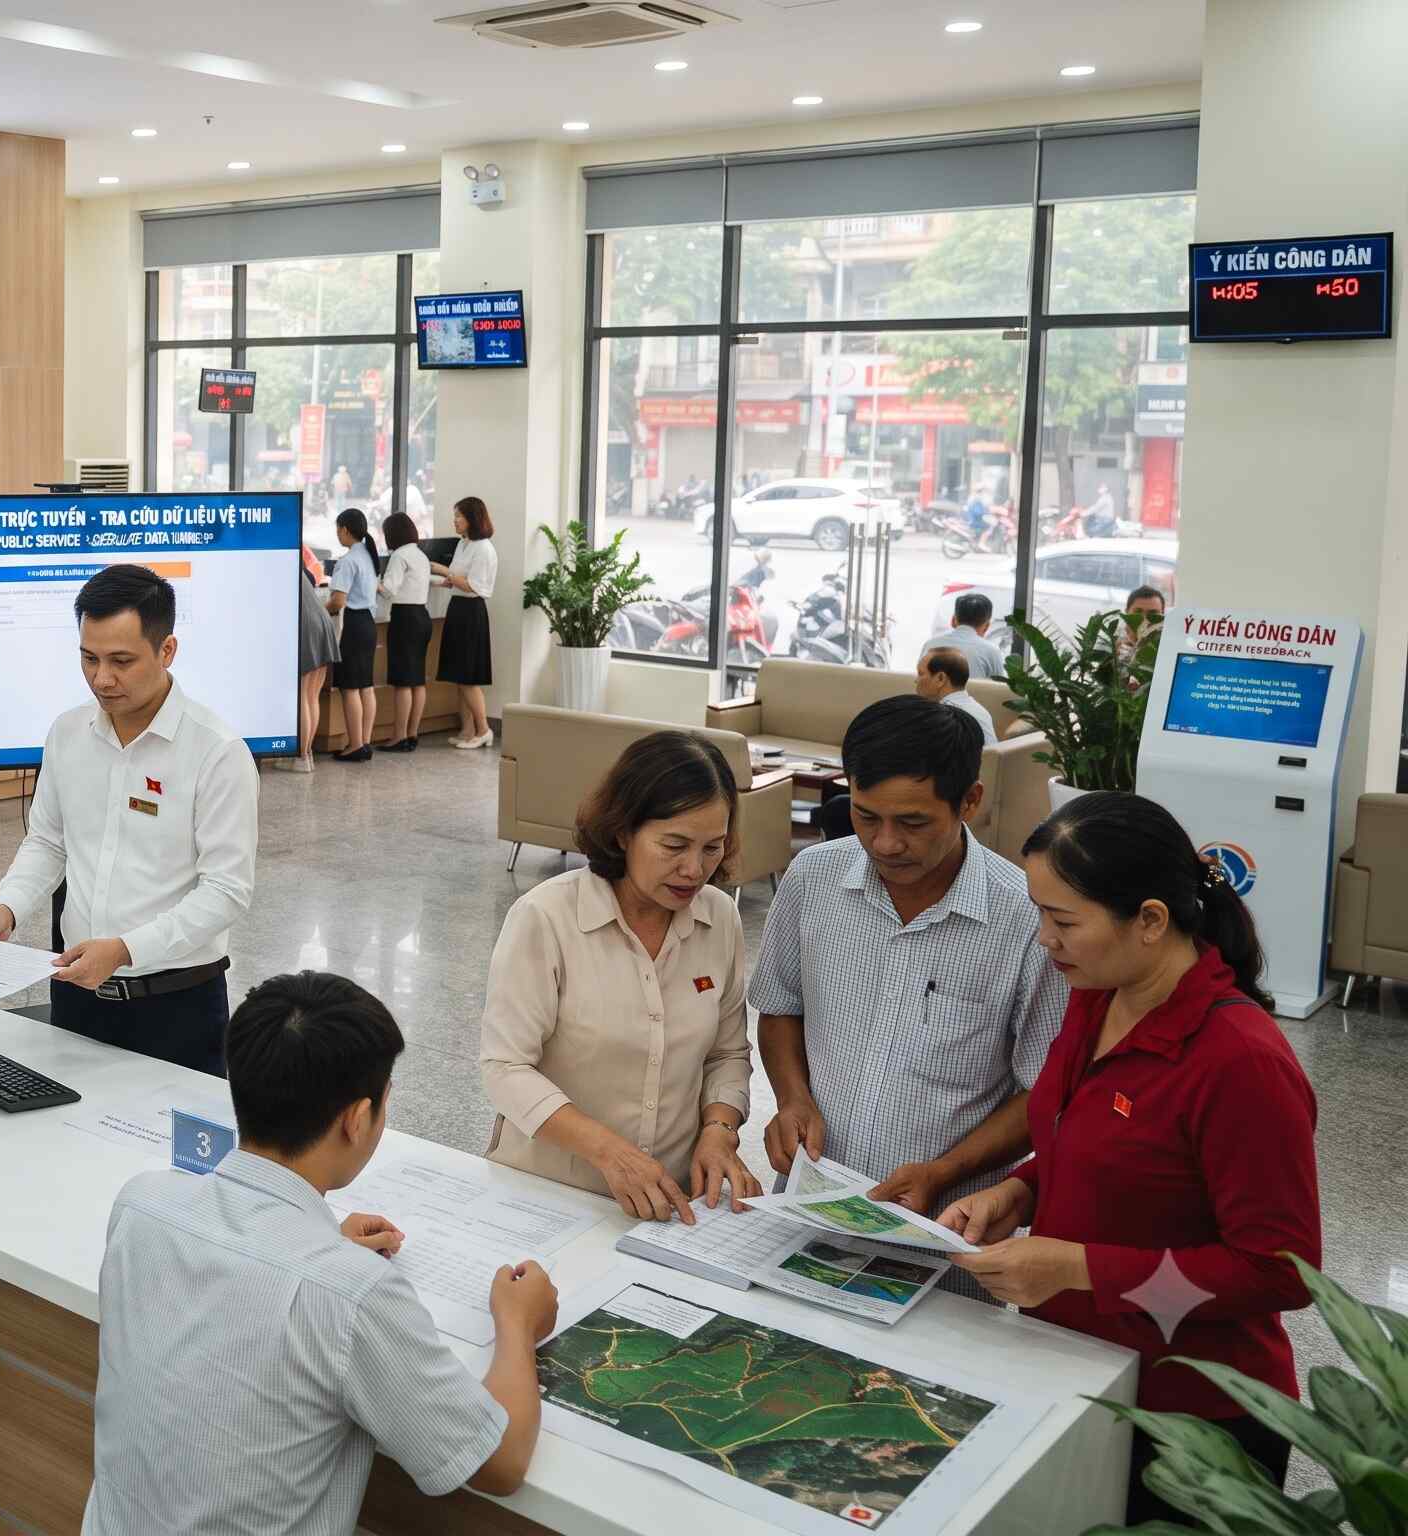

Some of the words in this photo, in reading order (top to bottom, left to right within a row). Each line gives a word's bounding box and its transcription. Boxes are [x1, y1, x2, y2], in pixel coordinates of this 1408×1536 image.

[1209, 250, 1222, 272] Ý
[1227, 246, 1269, 271] KIẾN
[1274, 247, 1326, 269] CÔNG
[1331, 244, 1372, 266] DÂN
[0, 509, 37, 532] TRỰC
[41, 505, 86, 527] TUYẾN
[99, 510, 127, 526] TRA
[130, 505, 159, 526] CỨU
[162, 505, 185, 526] DỮ
[185, 504, 216, 527] LIỆU
[218, 504, 236, 529] VỆ
[239, 507, 272, 524] TINH
[35, 533, 81, 548] SERVICE
[144, 531, 170, 545] DATA
[1184, 614, 1195, 635] Ý
[1198, 614, 1240, 638] KIẾN
[1244, 620, 1293, 643] CÔNG
[196, 1131, 212, 1158] 3
